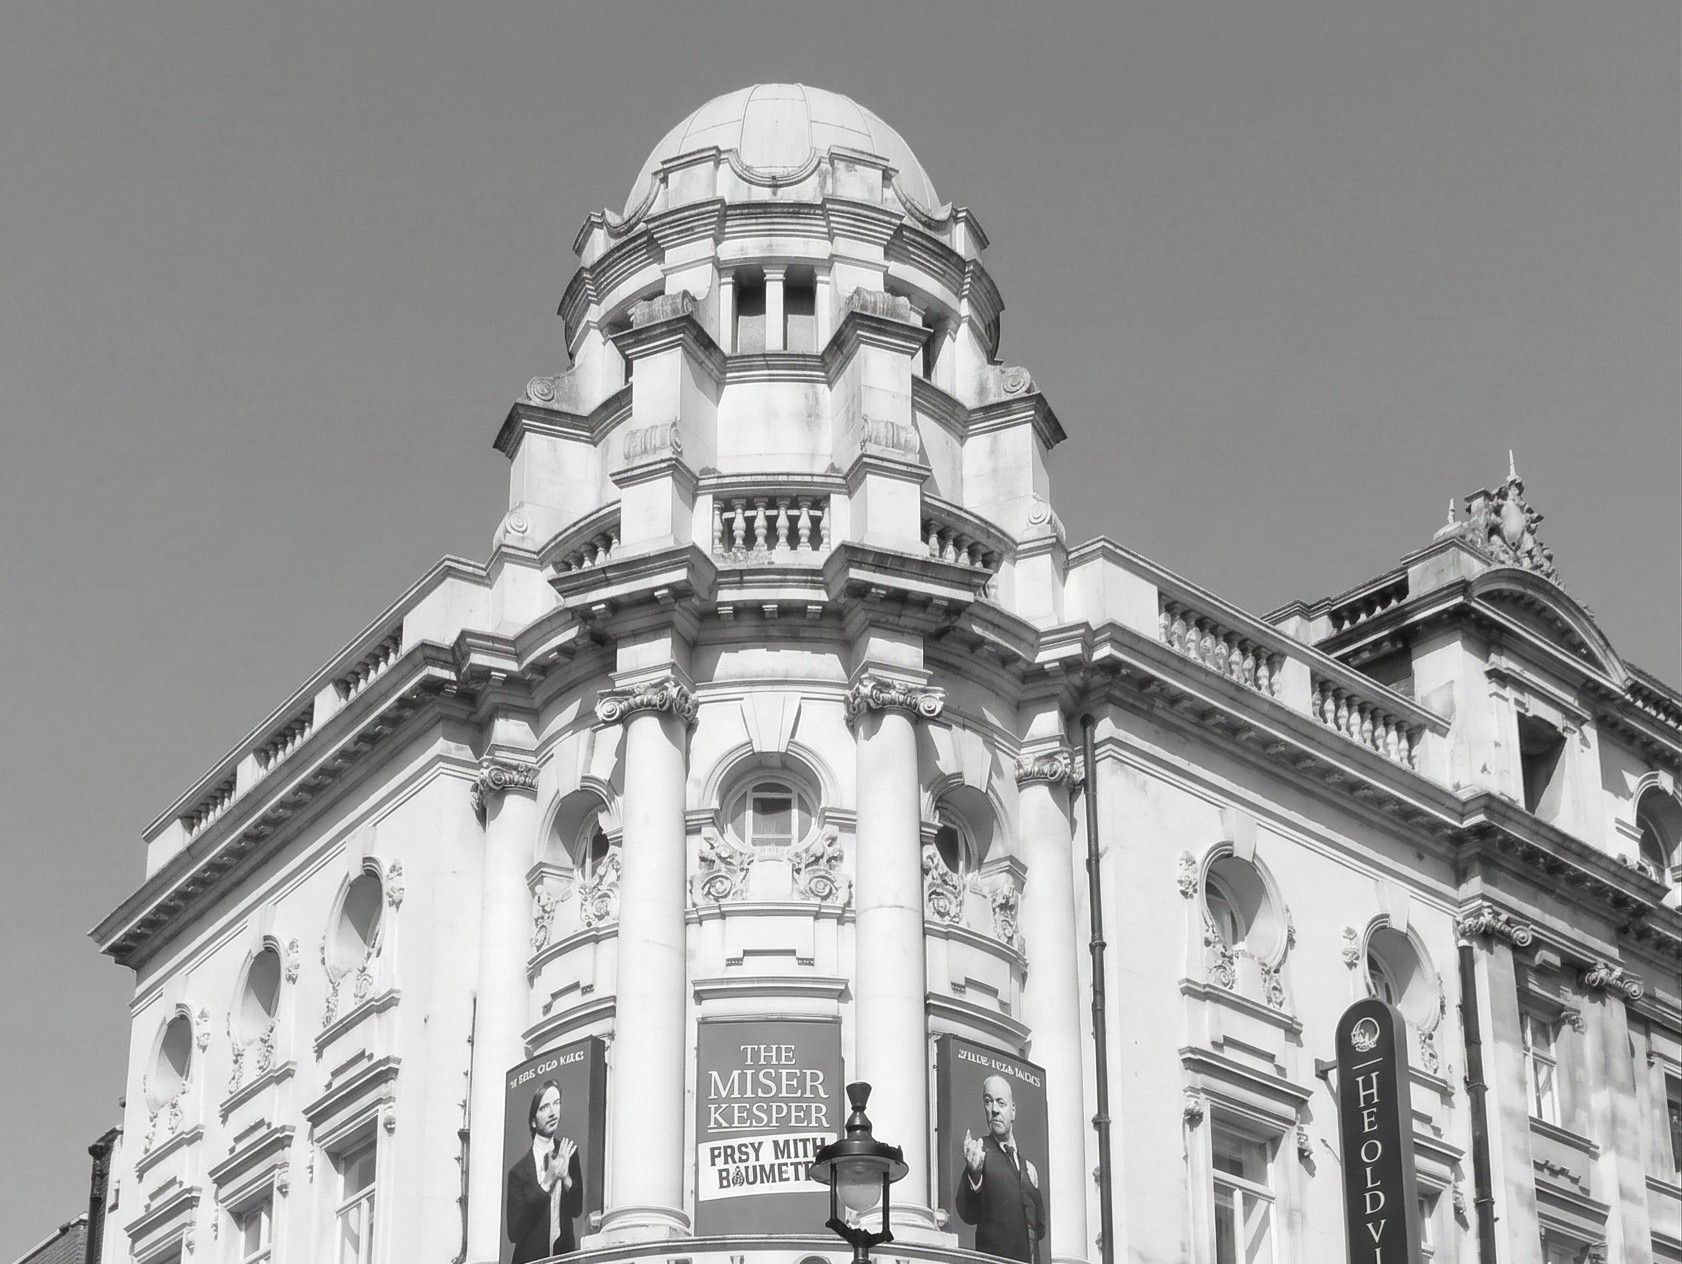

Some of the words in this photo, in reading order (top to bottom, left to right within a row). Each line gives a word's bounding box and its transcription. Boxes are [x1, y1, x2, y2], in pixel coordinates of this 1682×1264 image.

[741, 1045, 796, 1065] THE
[708, 1069, 829, 1099] MISER
[708, 1103, 831, 1128] KESPER
